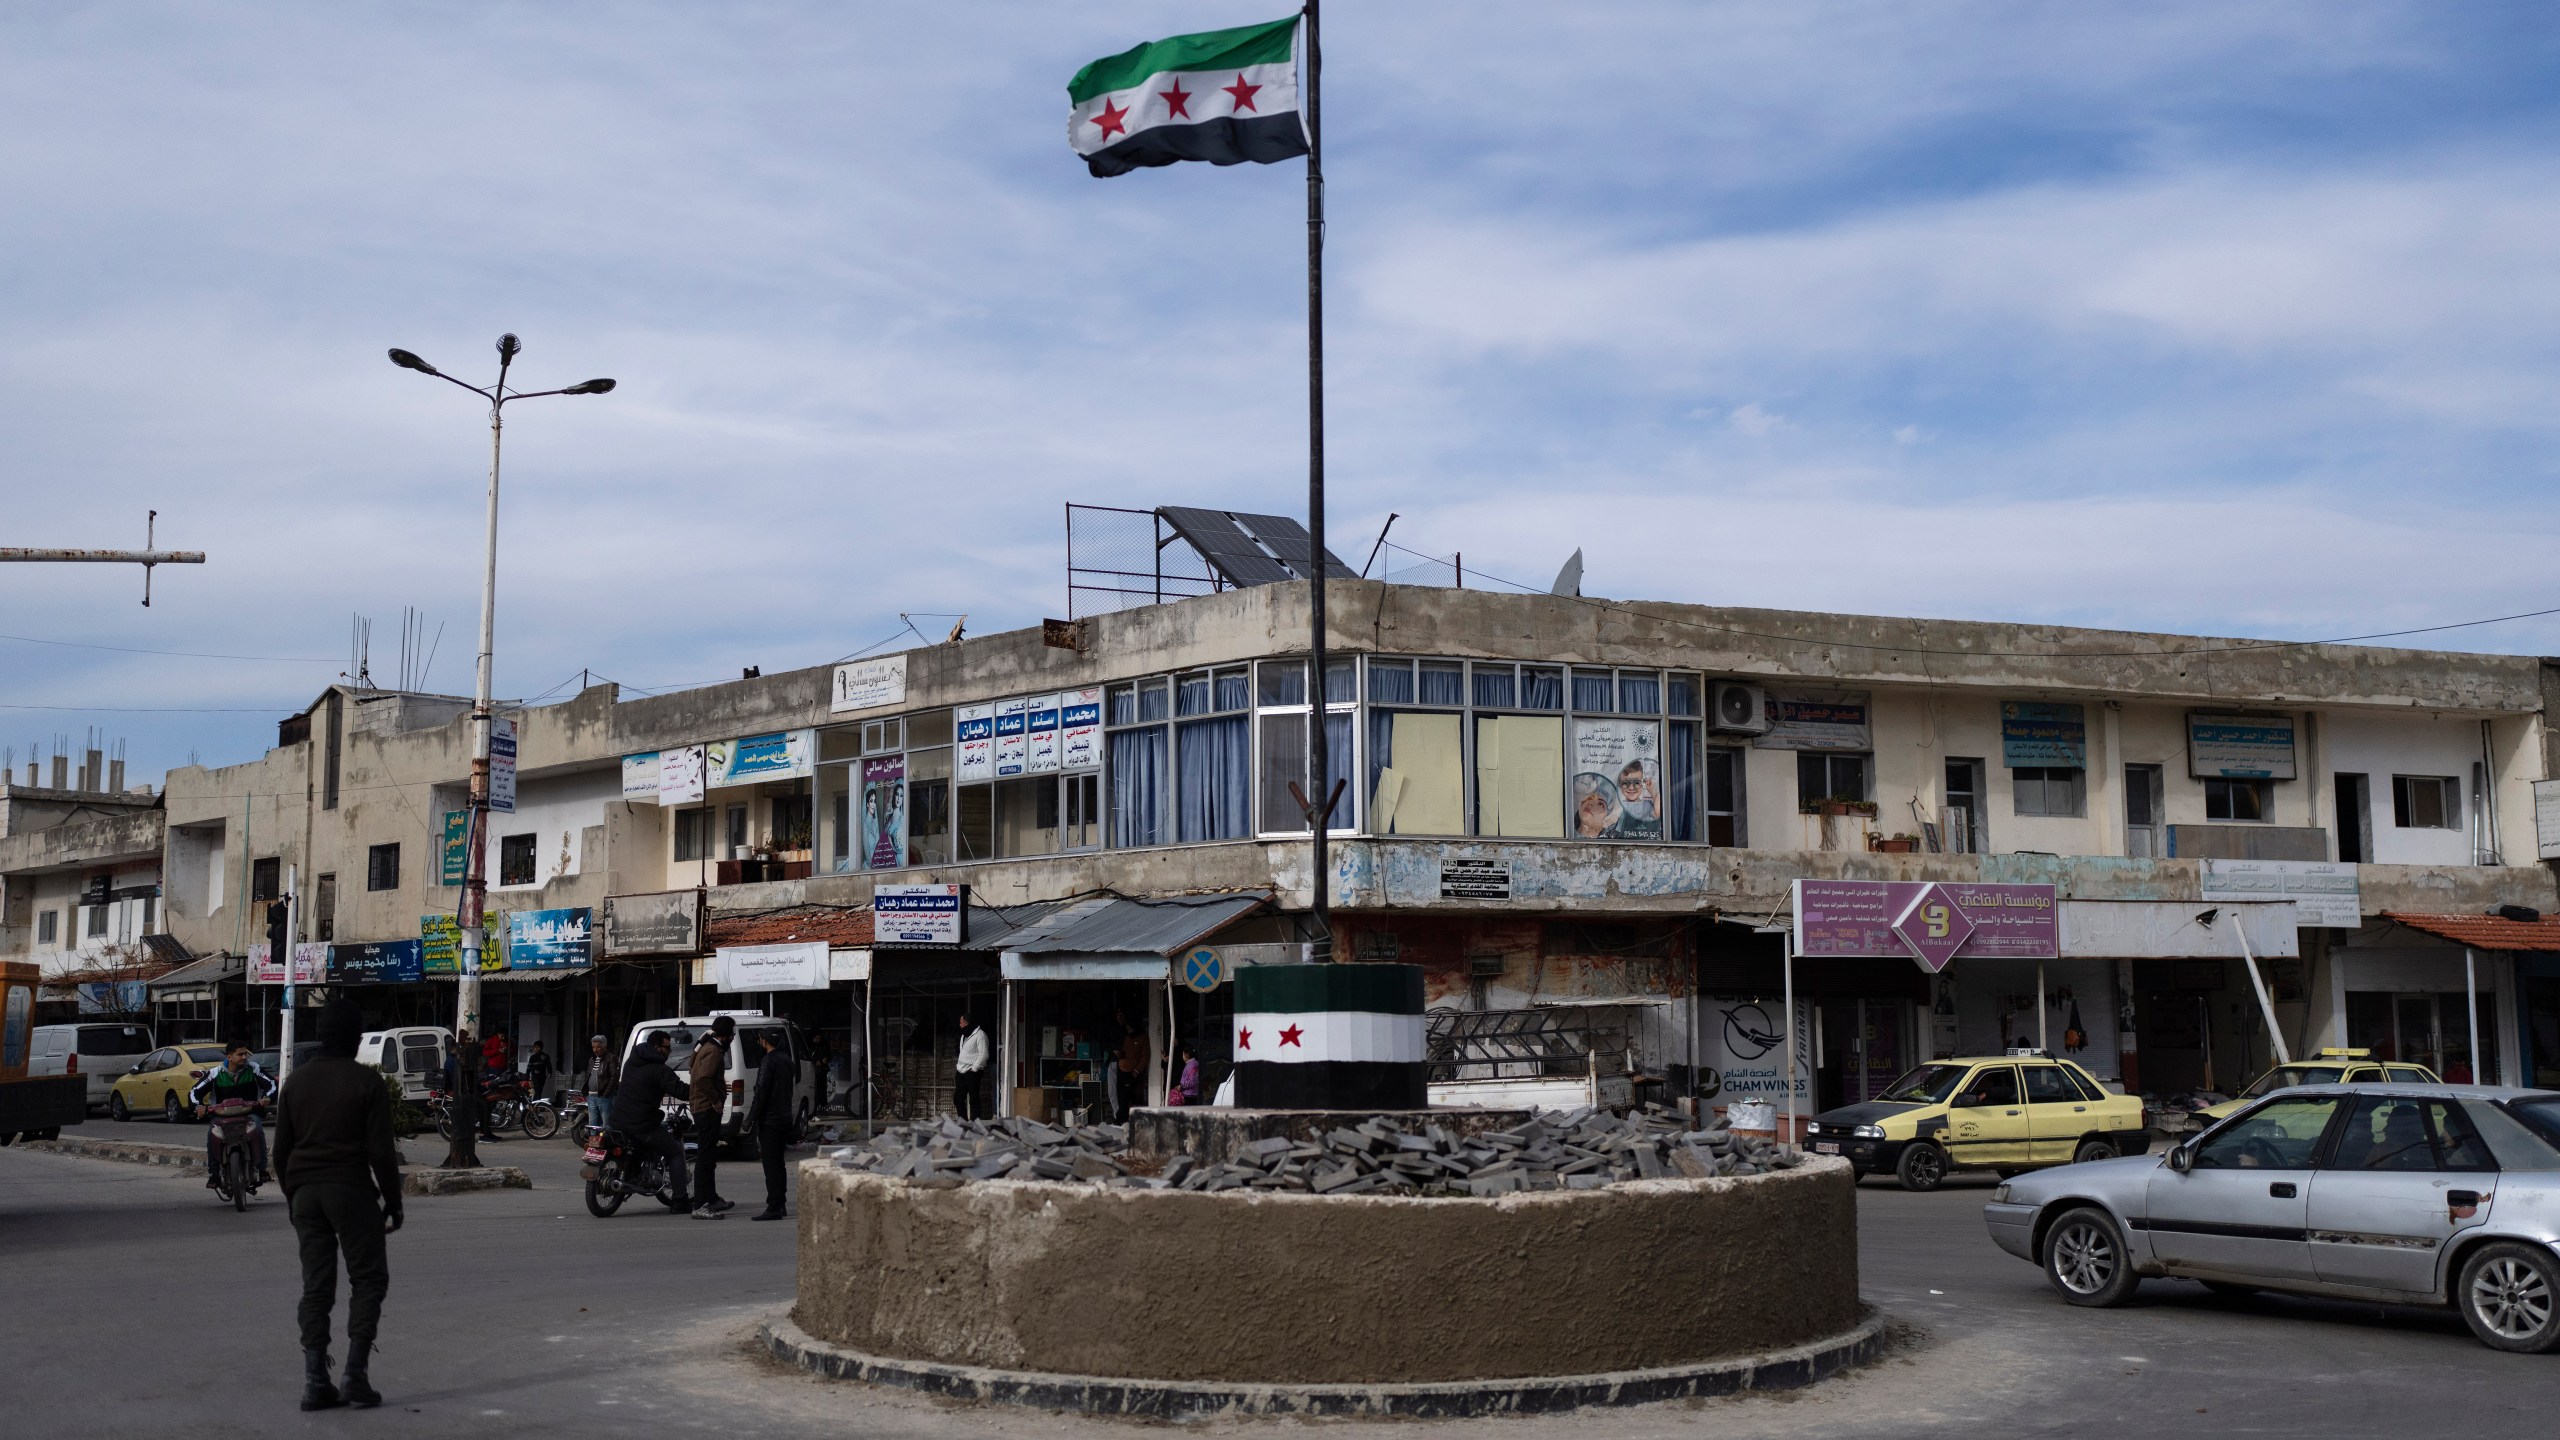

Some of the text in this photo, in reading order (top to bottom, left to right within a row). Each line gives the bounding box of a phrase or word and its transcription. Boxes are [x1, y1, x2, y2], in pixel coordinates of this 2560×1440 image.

[1004, 701, 1044, 714] الدكتور
[1797, 704, 1831, 721] حسين
[961, 709, 1096, 740] محمد سند عماد رهبان
[1032, 732, 1044, 742] طب
[1045, 732, 1053, 742] في
[1596, 735, 1611, 743] مروان
[2218, 729, 2240, 742] حسين
[2263, 730, 2290, 743] الدكتور
[866, 758, 904, 777] صالون سالي
[448, 813, 465, 830] مخبر
[2229, 865, 2261, 873] الدكتور
[1806, 888, 1820, 896] العالم
[1832, 888, 1845, 896] جميع
[1856, 888, 1871, 897] طيران
[1871, 888, 1888, 896] حجوزات
[878, 897, 955, 909] محمد سند عماد رهبان
[1812, 900, 1830, 908] سياحية
[1831, 900, 1850, 909] تأشيرات
[1852, 901, 1869, 909] سياحية
[1958, 892, 2051, 911] مؤسسة البقاعي
[1825, 915, 1838, 923] صحي
[1839, 913, 1852, 922] تأمين
[1855, 914, 1870, 922] فندقية
[1973, 914, 2034, 927] للسياحة والسفر
[343, 953, 401, 970] رشا محمد يونس
[1723, 1066, 1777, 1079] أجنحة الشام
[1724, 1080, 1761, 1092] CHAM
